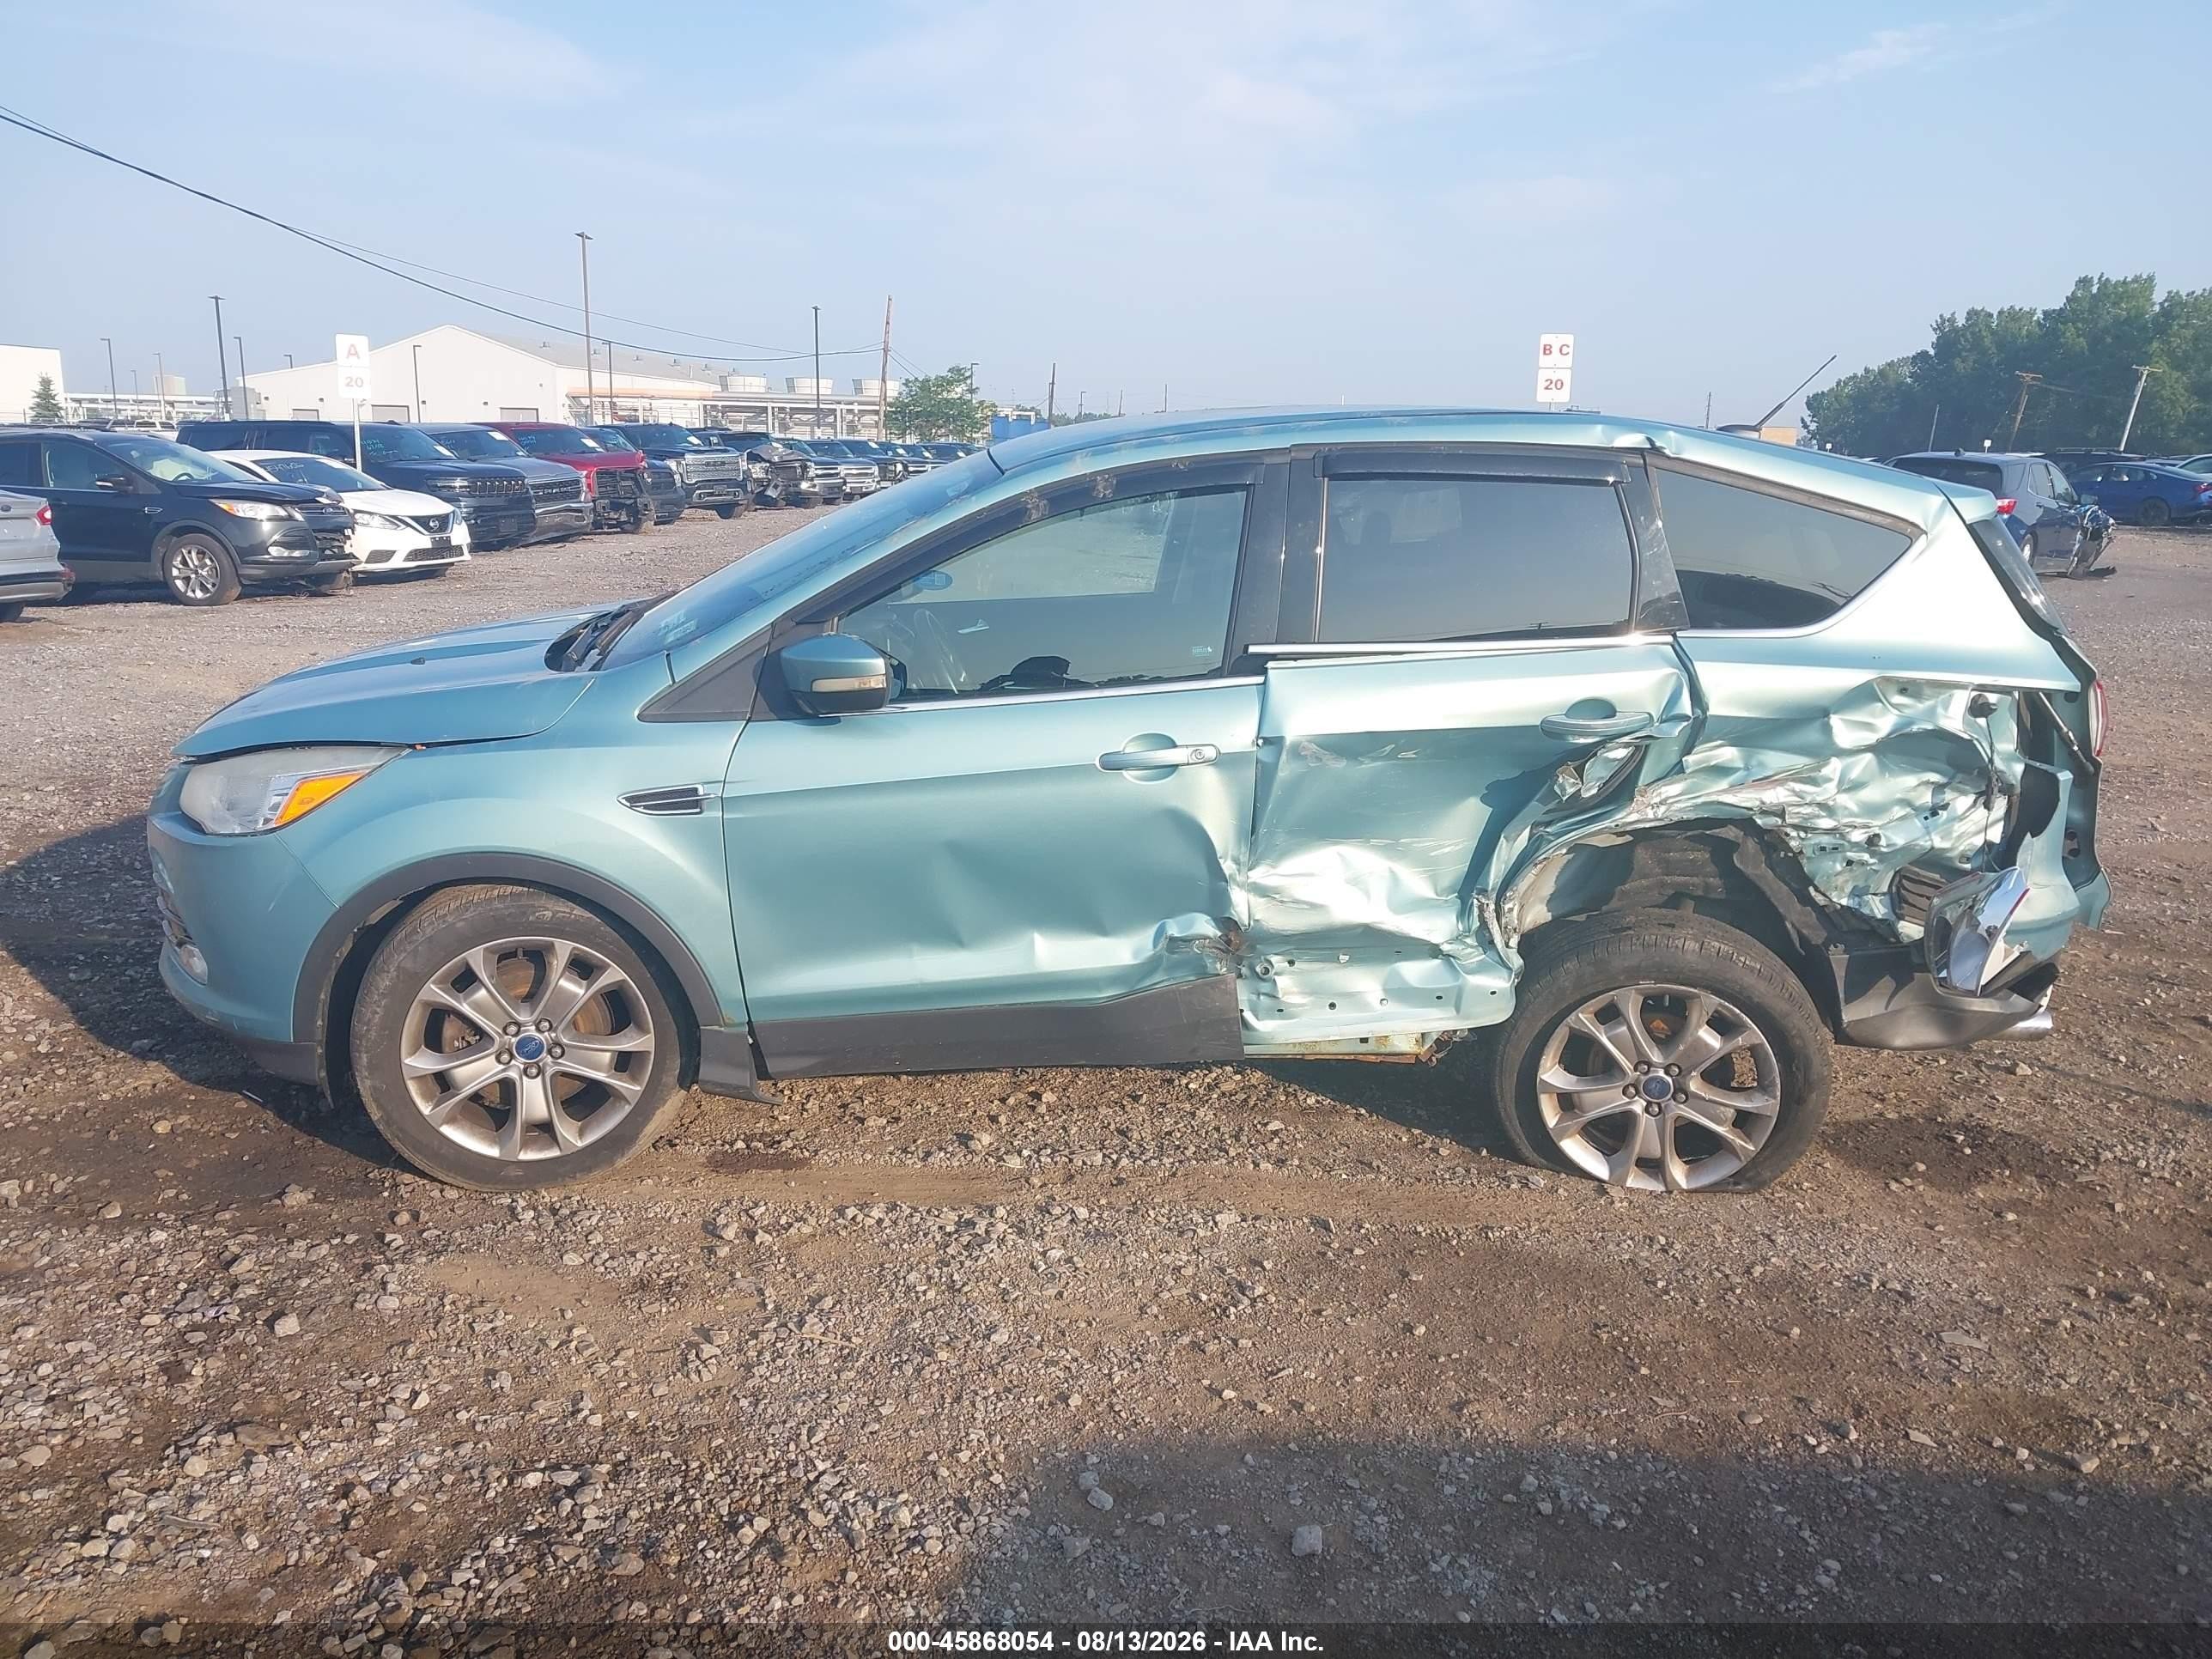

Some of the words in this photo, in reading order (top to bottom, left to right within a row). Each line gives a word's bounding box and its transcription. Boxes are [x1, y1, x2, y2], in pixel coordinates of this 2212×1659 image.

[346, 343, 361, 359] A
[1543, 343, 1553, 356] B
[1559, 343, 1571, 356] C
[345, 376, 364, 388] 20
[1543, 379, 1565, 391] 20
